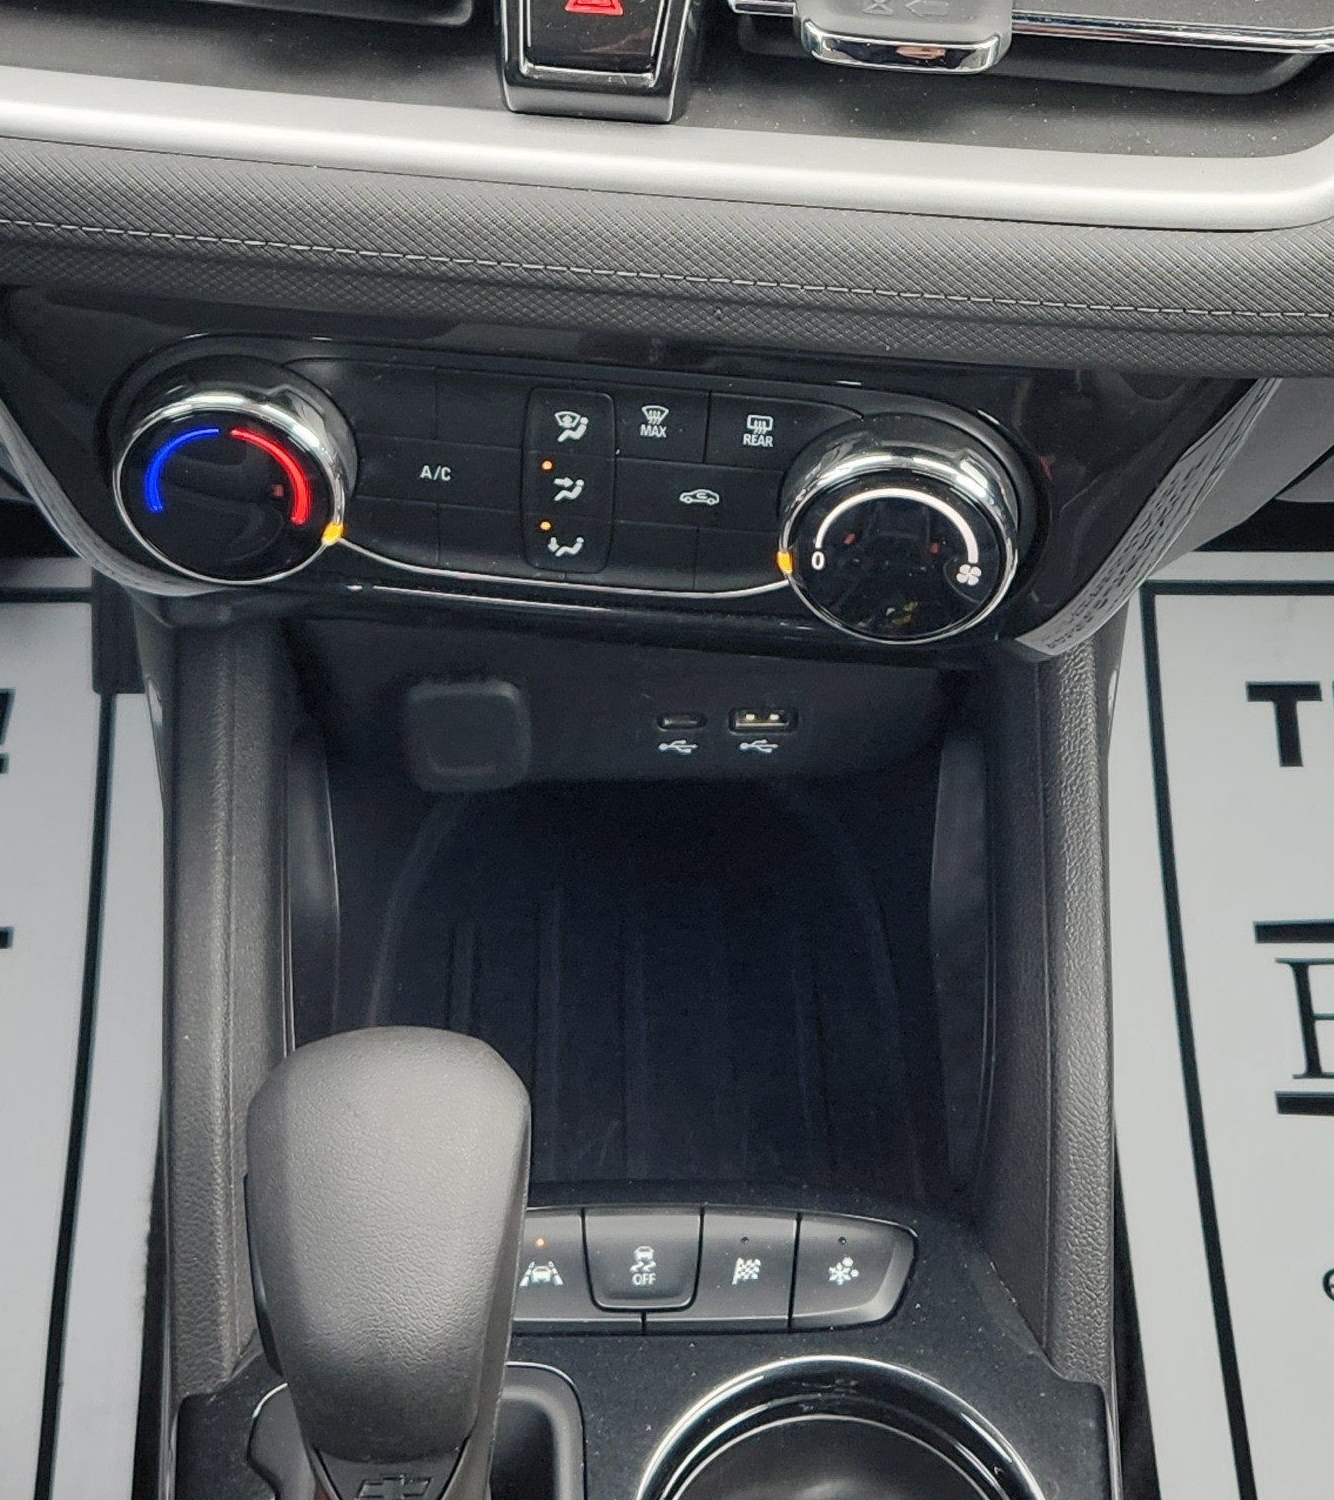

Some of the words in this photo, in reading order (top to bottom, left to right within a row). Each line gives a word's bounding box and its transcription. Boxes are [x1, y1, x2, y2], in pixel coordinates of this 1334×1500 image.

[639, 424, 668, 439] MAX
[742, 433, 774, 448] REAR
[419, 464, 453, 483] A/C
[632, 1273, 657, 1287] OFF
